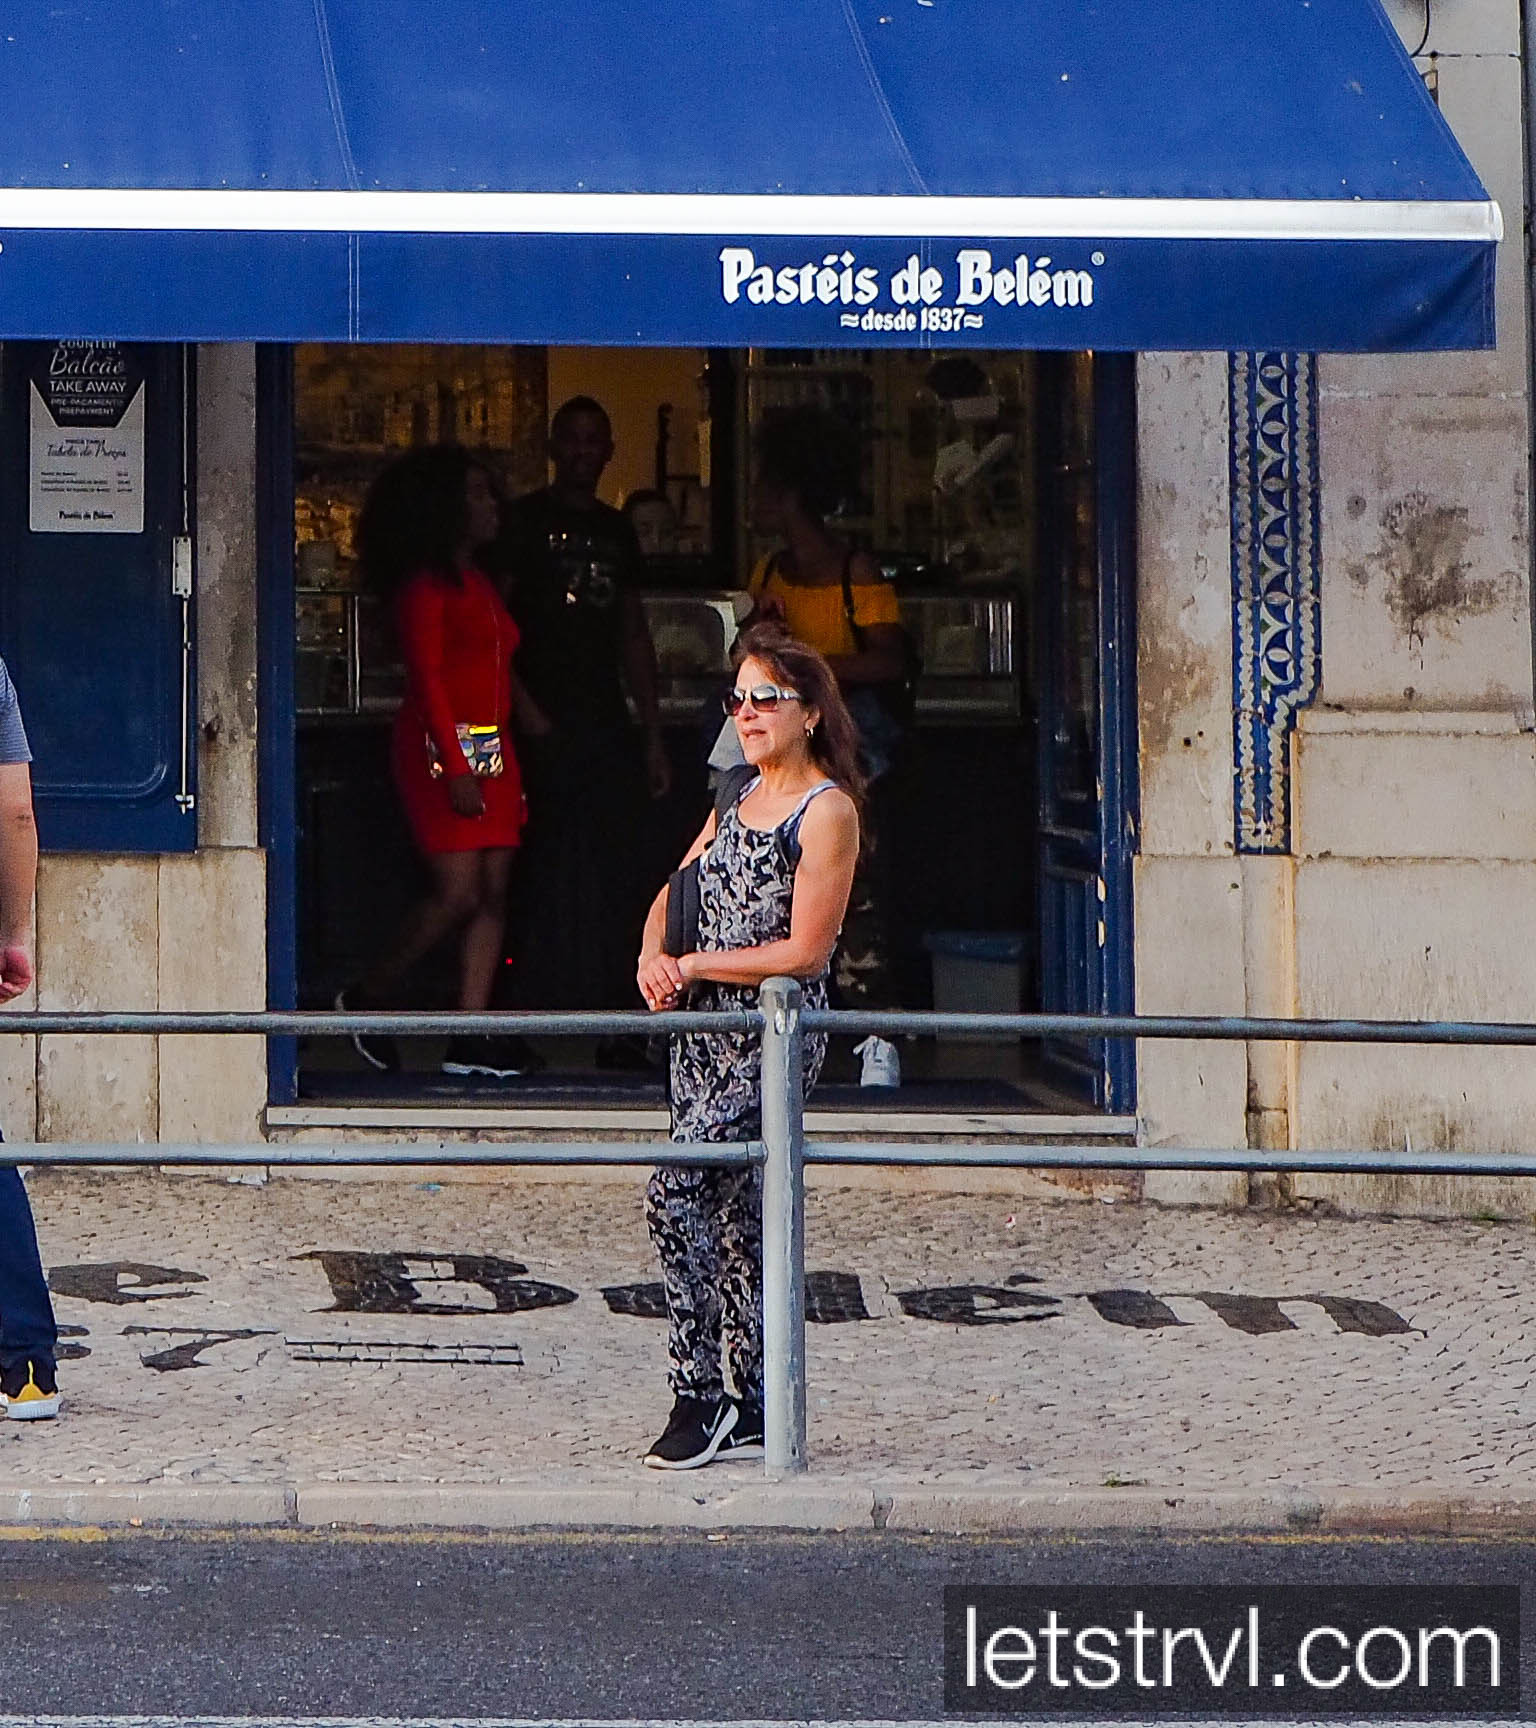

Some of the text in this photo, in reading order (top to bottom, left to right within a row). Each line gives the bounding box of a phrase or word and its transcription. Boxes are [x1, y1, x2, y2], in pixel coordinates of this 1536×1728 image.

[719, 247, 879, 305] Pastéis
[890, 254, 943, 306] de
[860, 307, 966, 332] desde 1837
[49, 379, 127, 393] TAKE AWAY
